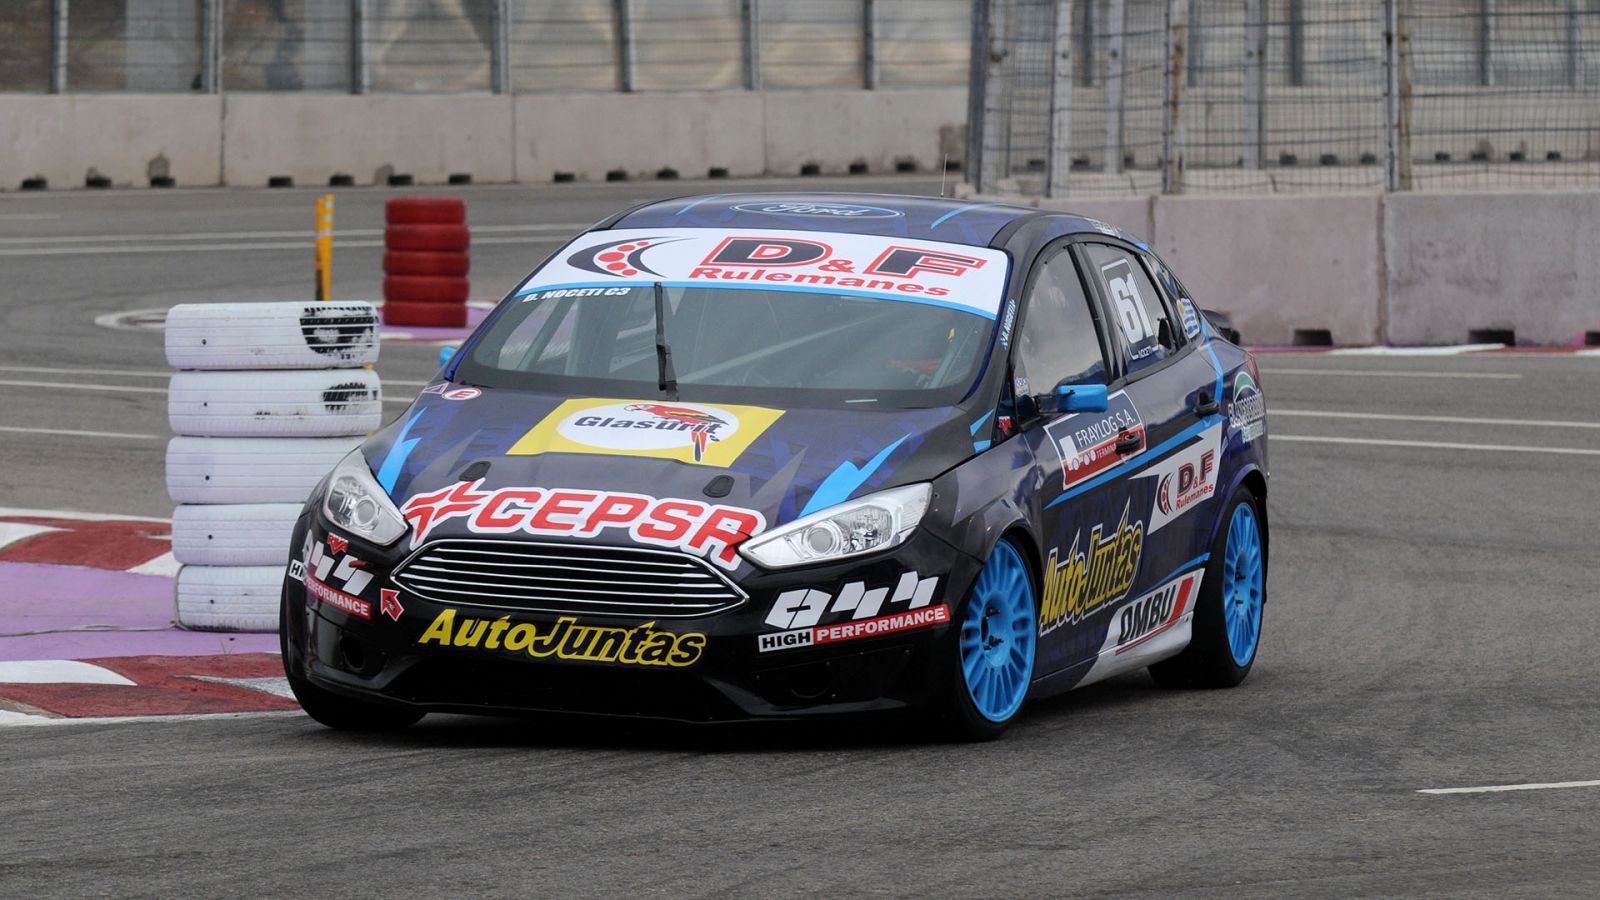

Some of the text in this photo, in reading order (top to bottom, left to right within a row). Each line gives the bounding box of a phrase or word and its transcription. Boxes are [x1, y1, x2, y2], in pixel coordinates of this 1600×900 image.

[762, 202, 869, 216] Ford
[699, 236, 987, 280] D&F
[541, 288, 605, 300] NOCETI
[604, 287, 631, 296] C3
[688, 266, 951, 297] Rulemanes
[1109, 273, 1154, 344] 61
[574, 415, 723, 435] Glasurit
[1075, 408, 1136, 448] FRAYLOG S.A.
[1177, 448, 1214, 498] D&F
[1176, 484, 1214, 510] Rulemanes
[474, 489, 760, 567] CEPSA
[762, 607, 946, 649] HIGH PERFORMANCE
[1118, 585, 1176, 645] OMBU
[418, 608, 706, 668] AutoJuntas
